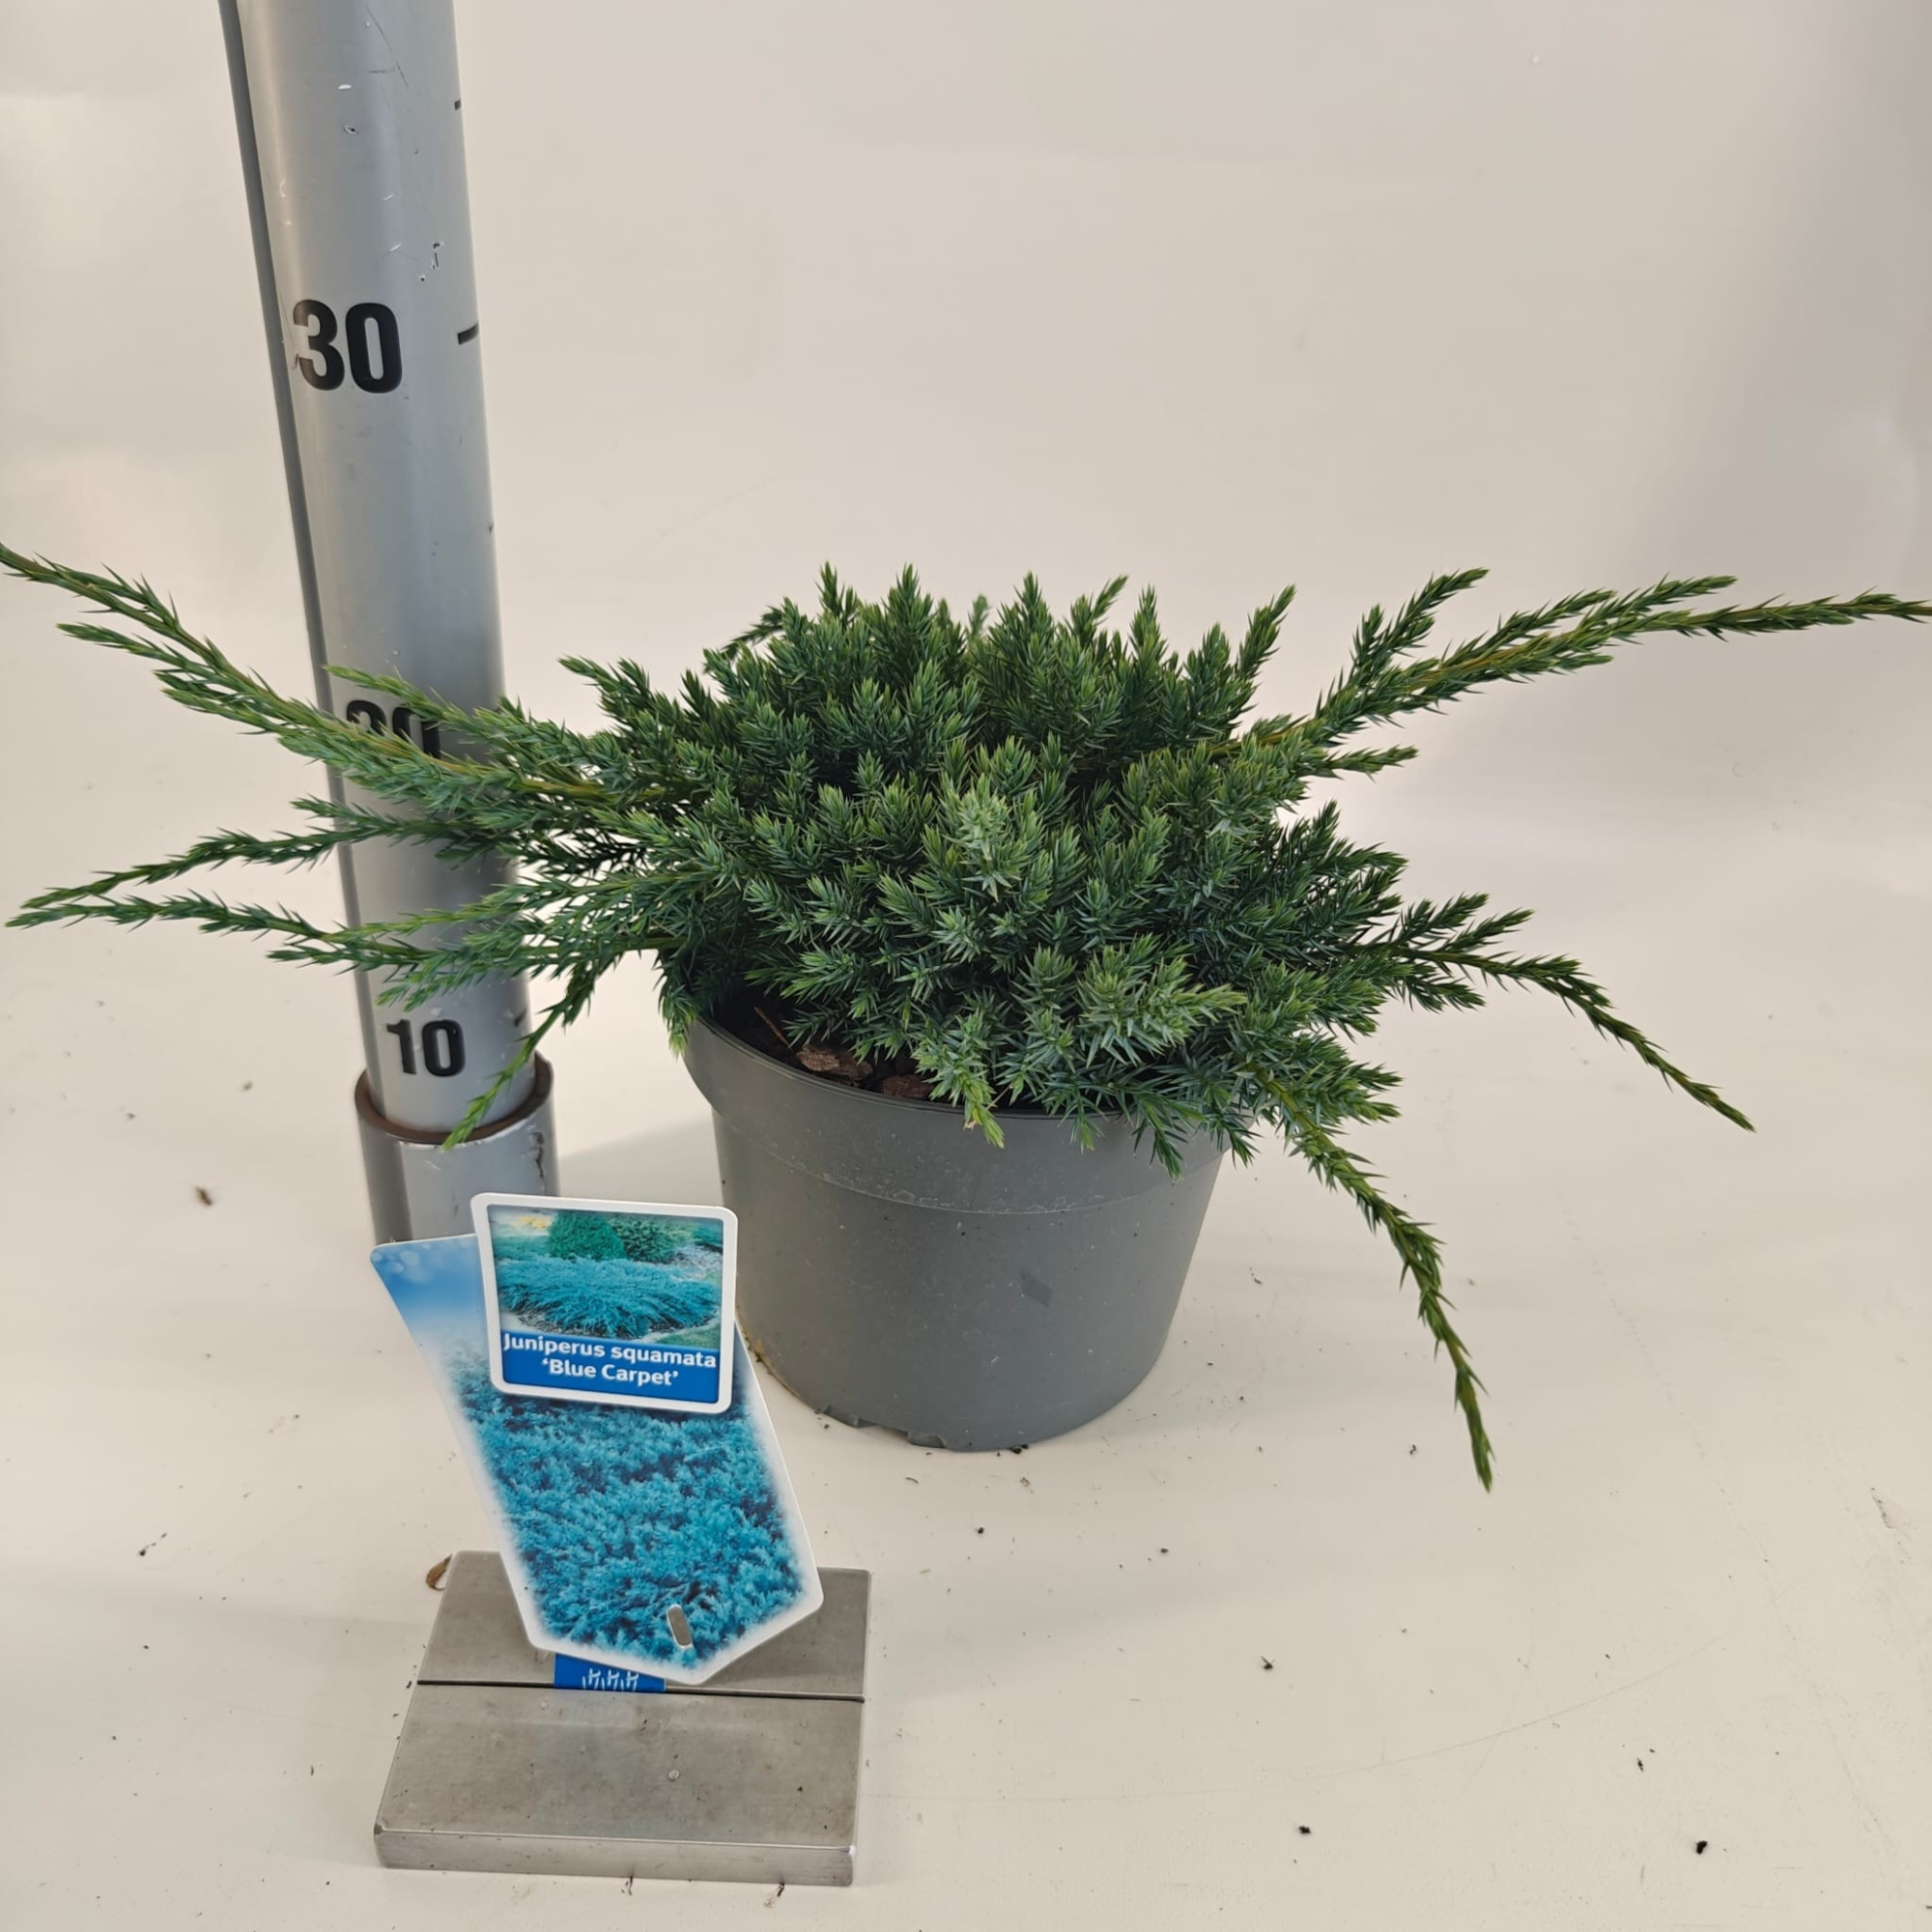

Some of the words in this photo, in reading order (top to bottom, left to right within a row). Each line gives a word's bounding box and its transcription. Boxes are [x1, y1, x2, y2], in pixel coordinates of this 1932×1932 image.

[293, 299, 403, 394] 30
[386, 1018, 466, 1077] 10
[503, 1333, 606, 1358] Juniperus
[611, 1345, 717, 1368] squamata
